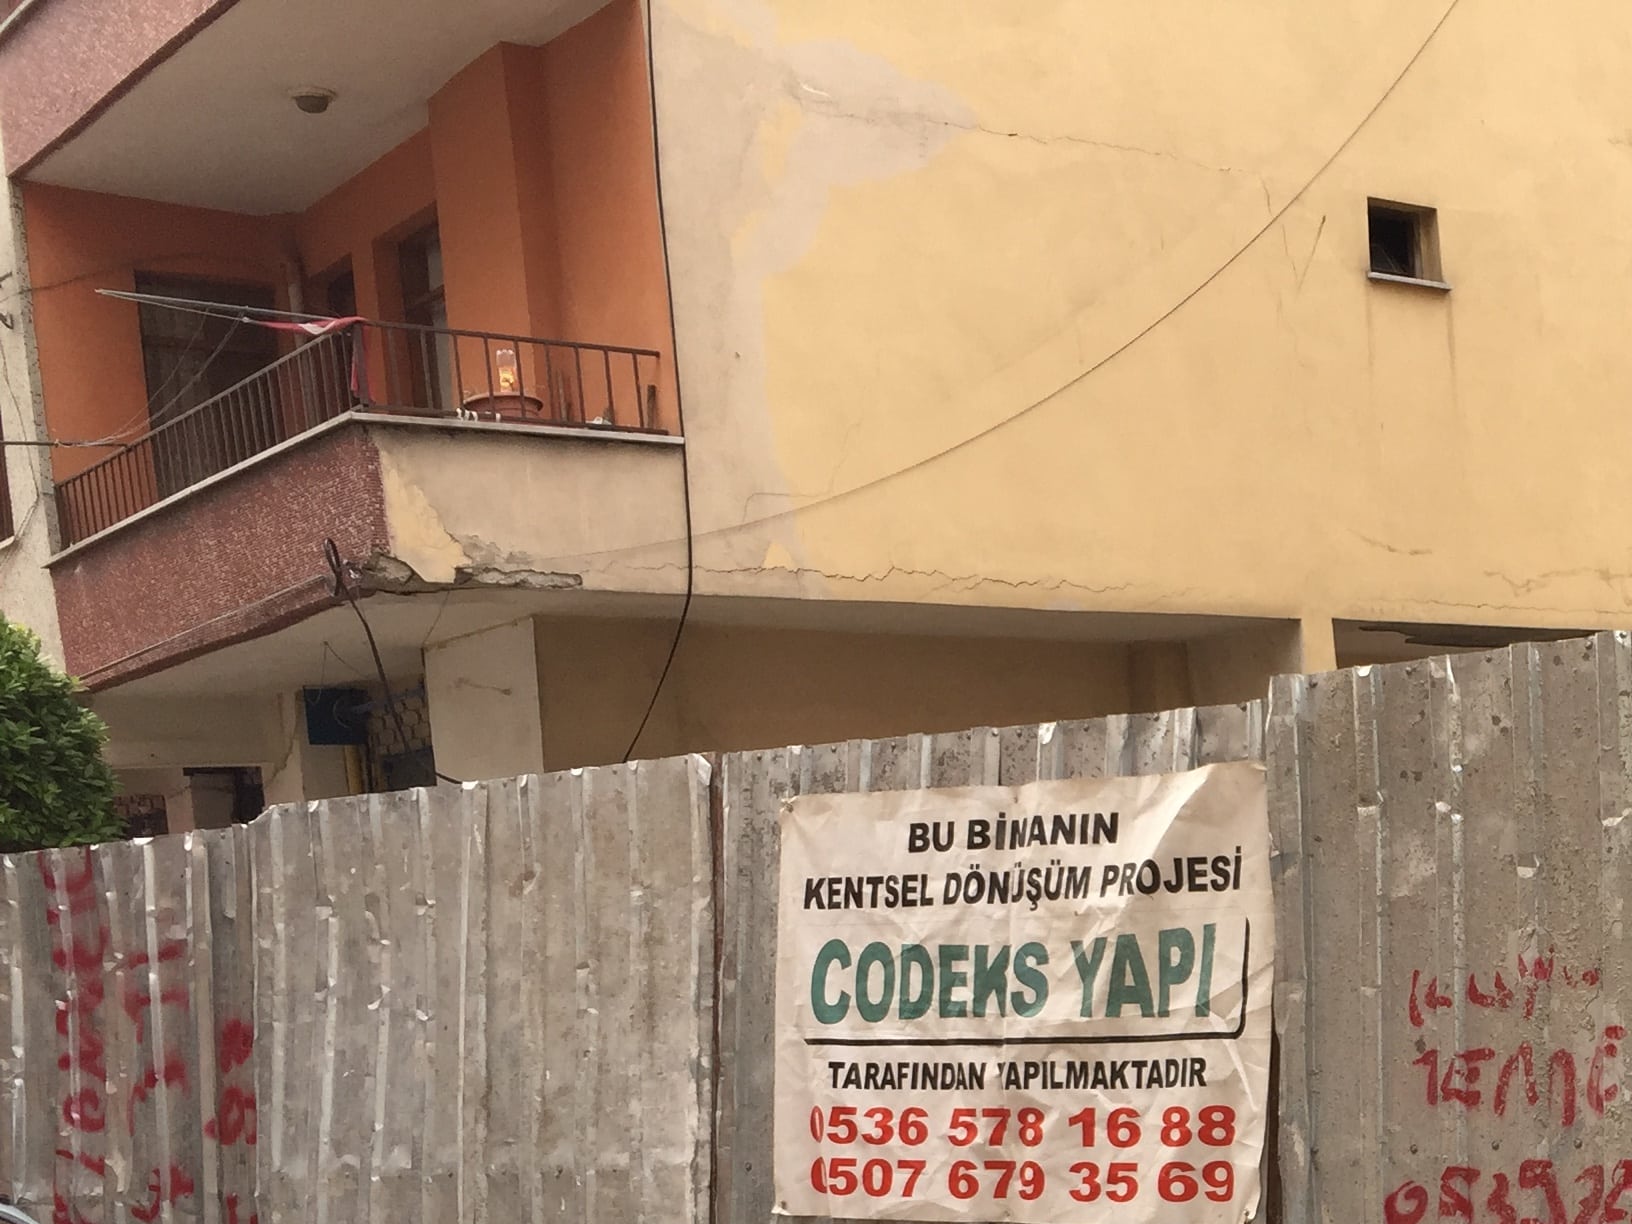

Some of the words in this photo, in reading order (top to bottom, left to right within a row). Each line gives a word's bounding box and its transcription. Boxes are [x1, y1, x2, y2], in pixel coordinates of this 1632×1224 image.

[908, 821, 955, 854] BU
[966, 811, 1119, 851] BİNANIN
[803, 873, 934, 910] KENTSEL
[943, 862, 1091, 911] DÖNÜŞÜM
[1100, 845, 1242, 896] PROJESİ
[810, 939, 1047, 1024] CODEKS
[1070, 922, 1215, 1019] YAPI
[828, 1061, 987, 1091] TARAFINDAN
[997, 1057, 1207, 1091] APILMAKTADIR
[809, 1105, 929, 1147] 0536
[947, 1107, 1045, 1148] 578
[1067, 1106, 1142, 1149] 16
[1159, 1104, 1236, 1148] 88
[809, 1156, 927, 1199] 0507
[947, 1159, 1046, 1202] 679
[1069, 1160, 1139, 1204] 35
[1156, 1160, 1235, 1204] 69
